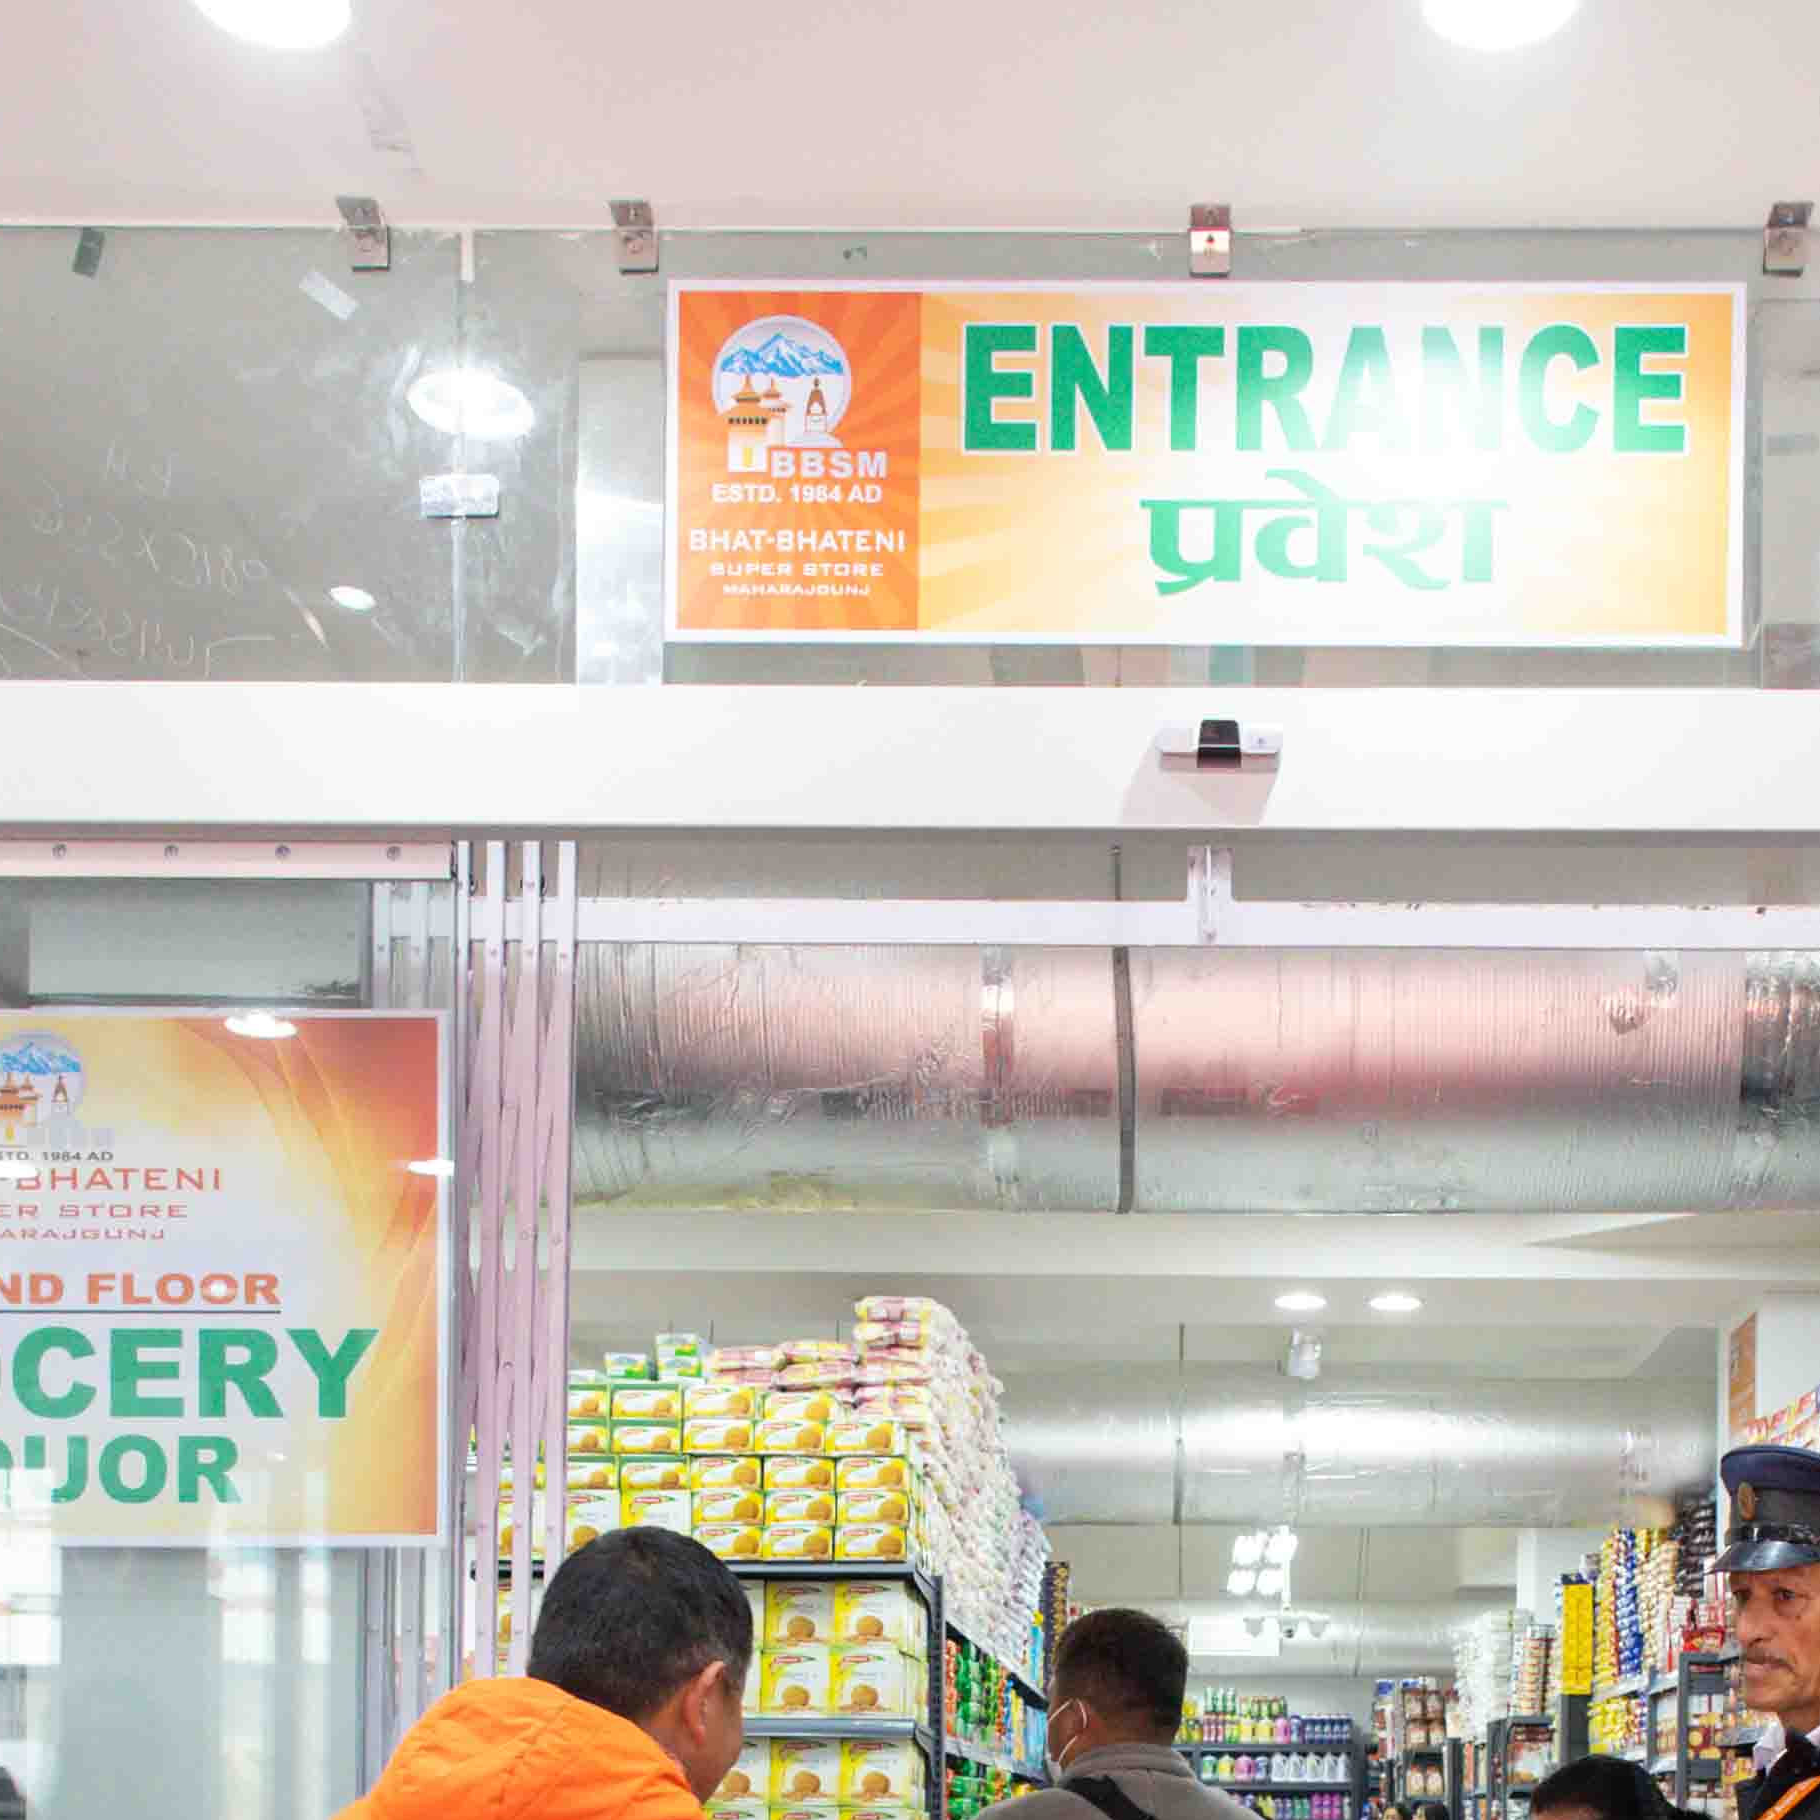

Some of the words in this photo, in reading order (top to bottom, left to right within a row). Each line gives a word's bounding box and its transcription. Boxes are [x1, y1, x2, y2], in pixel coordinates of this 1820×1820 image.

[961, 323, 1686, 453] ENTRANCE
[770, 450, 888, 479] BBSM
[710, 483, 781, 503] ESTD.
[790, 484, 843, 503] 1984
[846, 484, 884, 503] AD
[689, 528, 907, 553] BHAT-BHATENI
[1139, 470, 1512, 596] प्रवेश
[709, 561, 794, 578] SUPER
[802, 561, 885, 578] STORE
[42, 1150, 82, 1163] 1984
[86, 1150, 115, 1163] AD
[57, 1203, 189, 1219] STORE
[86, 1272, 283, 1306] FLOOR
